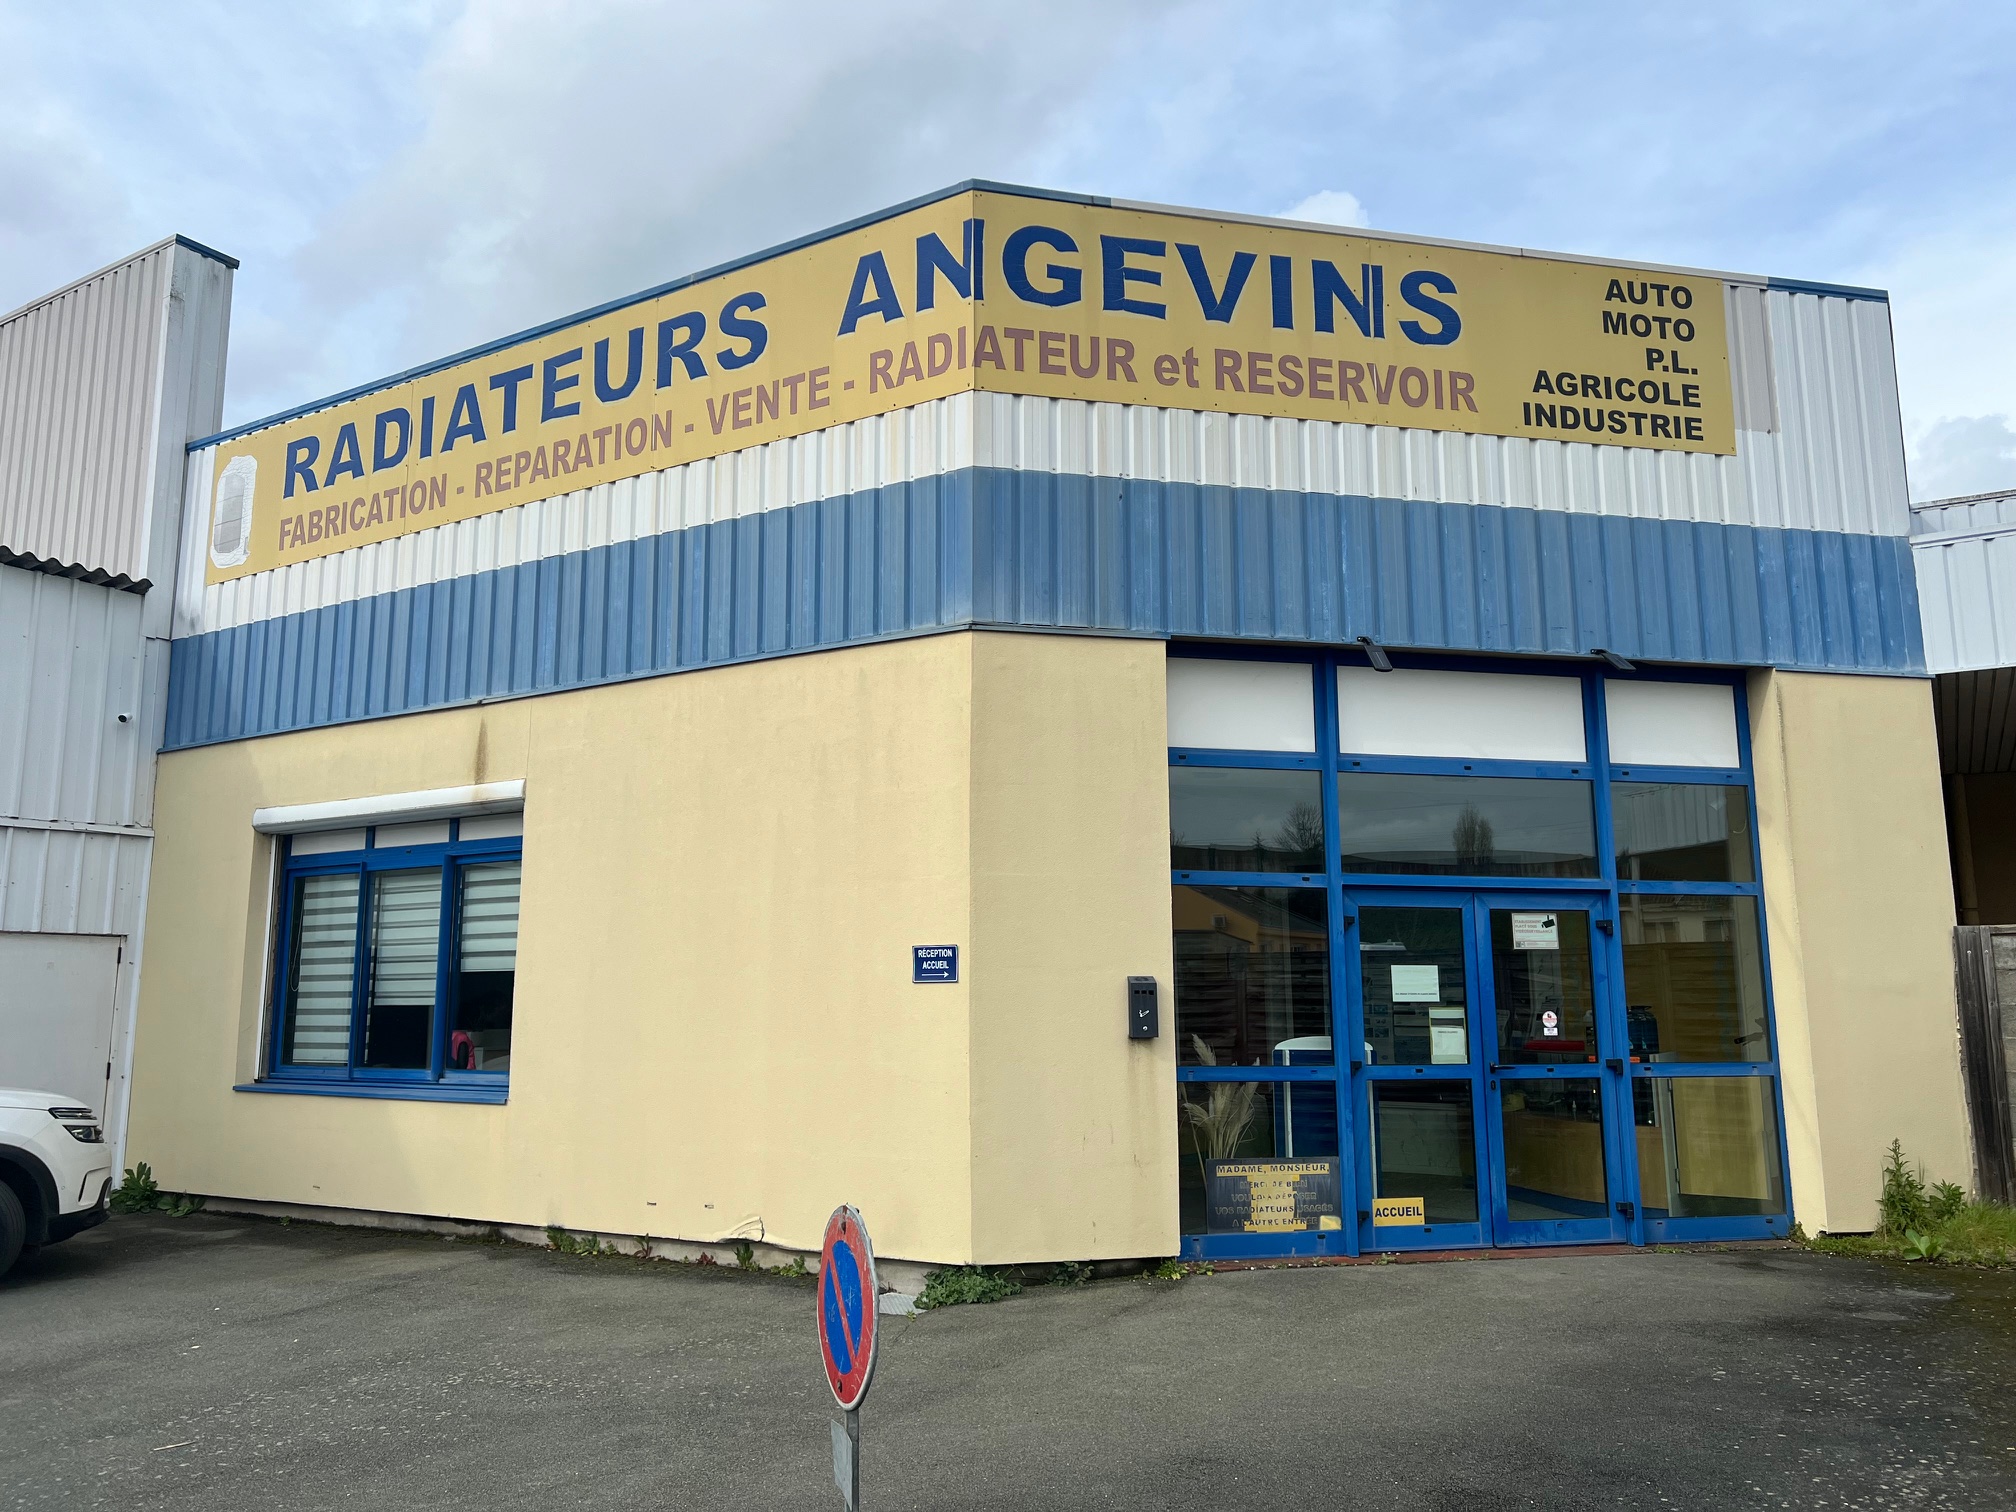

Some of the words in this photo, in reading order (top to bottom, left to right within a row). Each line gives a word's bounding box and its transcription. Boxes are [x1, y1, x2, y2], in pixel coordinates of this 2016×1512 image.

[1605, 278, 1693, 309] AUTO
[1602, 310, 1695, 342] MOTO
[283, 291, 768, 500] RADIATEURS
[837, 218, 1463, 346] ANGEVINS
[1645, 347, 1698, 375] P.L.
[1532, 369, 1701, 408] AGRICOLE
[1523, 401, 1704, 441] INDUSTRIE
[278, 473, 448, 551] FABRICATION
[474, 410, 672, 498] REPARATION
[706, 366, 831, 435] VENTE
[869, 325, 1138, 394] RADIATEUR
[1154, 347, 1199, 388] et
[1215, 348, 1479, 413] RESERVOIR
[918, 948, 952, 958] RÉCEPTION
[922, 961, 949, 969] ACCUEIL
[1217, 1165, 1267, 1174] MADAME,
[1270, 1164, 1330, 1173] MONSIEUR,
[1374, 1206, 1423, 1218] ACCUEIL
